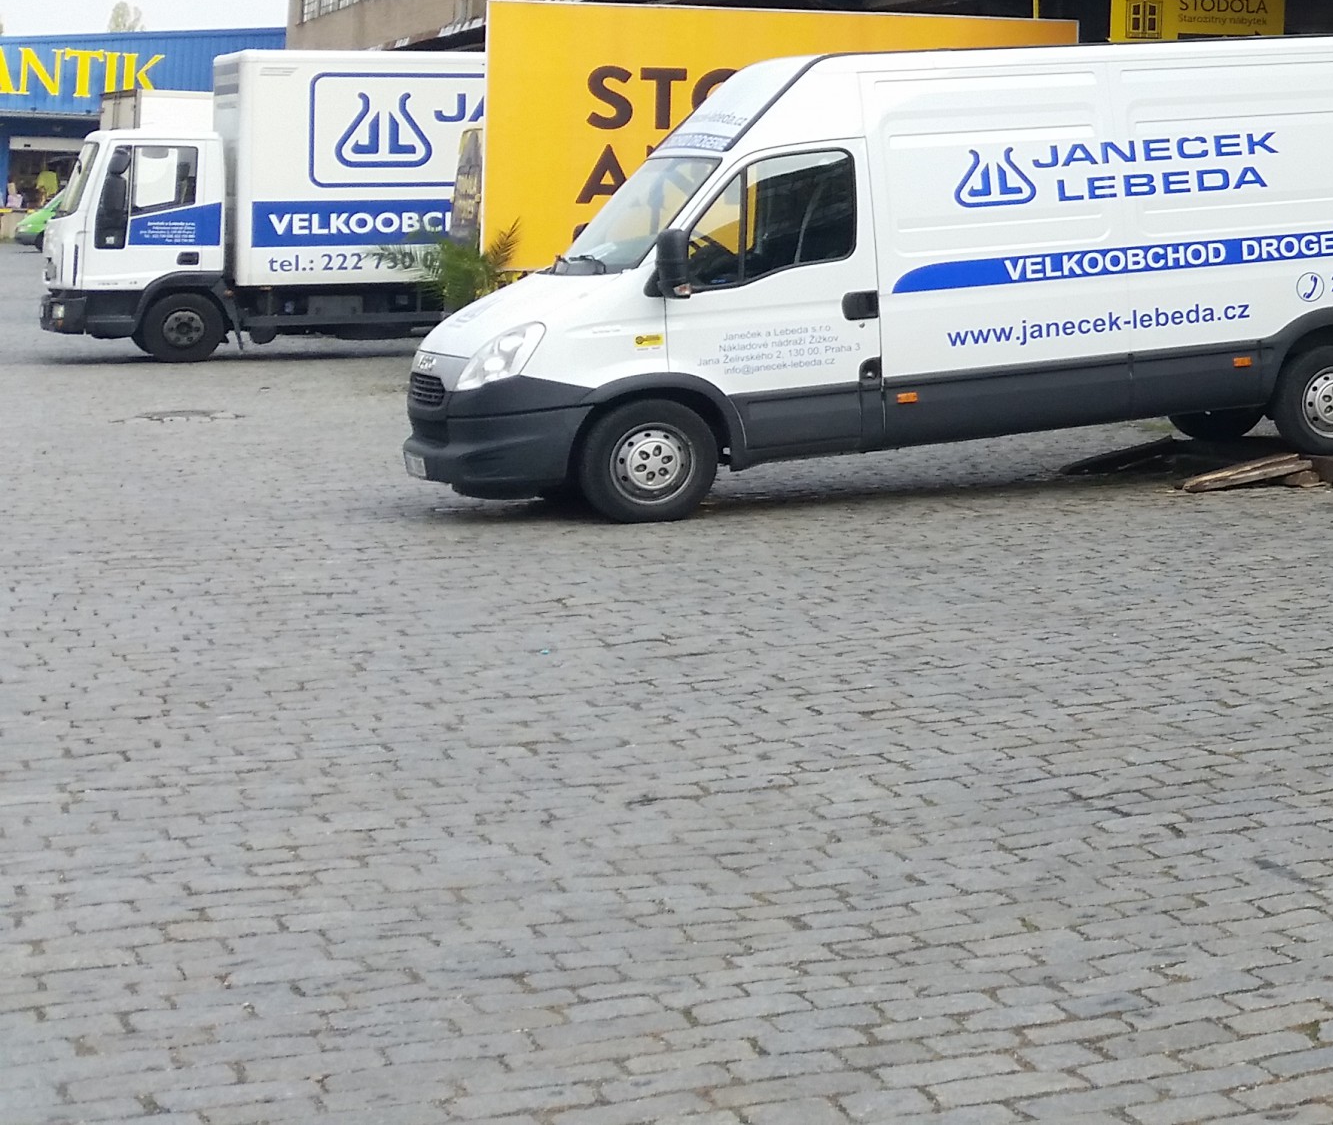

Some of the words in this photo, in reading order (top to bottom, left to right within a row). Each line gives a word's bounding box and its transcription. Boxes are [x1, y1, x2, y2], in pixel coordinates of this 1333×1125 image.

[1056, 166, 1268, 202] LEBEDA
[268, 254, 315, 273] tel.:
[321, 253, 364, 272] 222
[1004, 242, 1227, 281] VELKOOBCHOD
[723, 330, 762, 342] Janeček
[774, 326, 808, 337] Lebeda
[947, 303, 1250, 347] www.janecek-lebeda.cz
[719, 340, 769, 353] Nákladové
[771, 336, 807, 348] nádraží
[808, 333, 839, 344] Žižkov
[697, 357, 721, 368] Jana
[723, 352, 774, 365] Želivského
[788, 348, 807, 358] 130
[825, 344, 852, 354] Praha
[854, 342, 861, 352] 3
[724, 356, 836, 376] info@janecek-lebeda.cz
